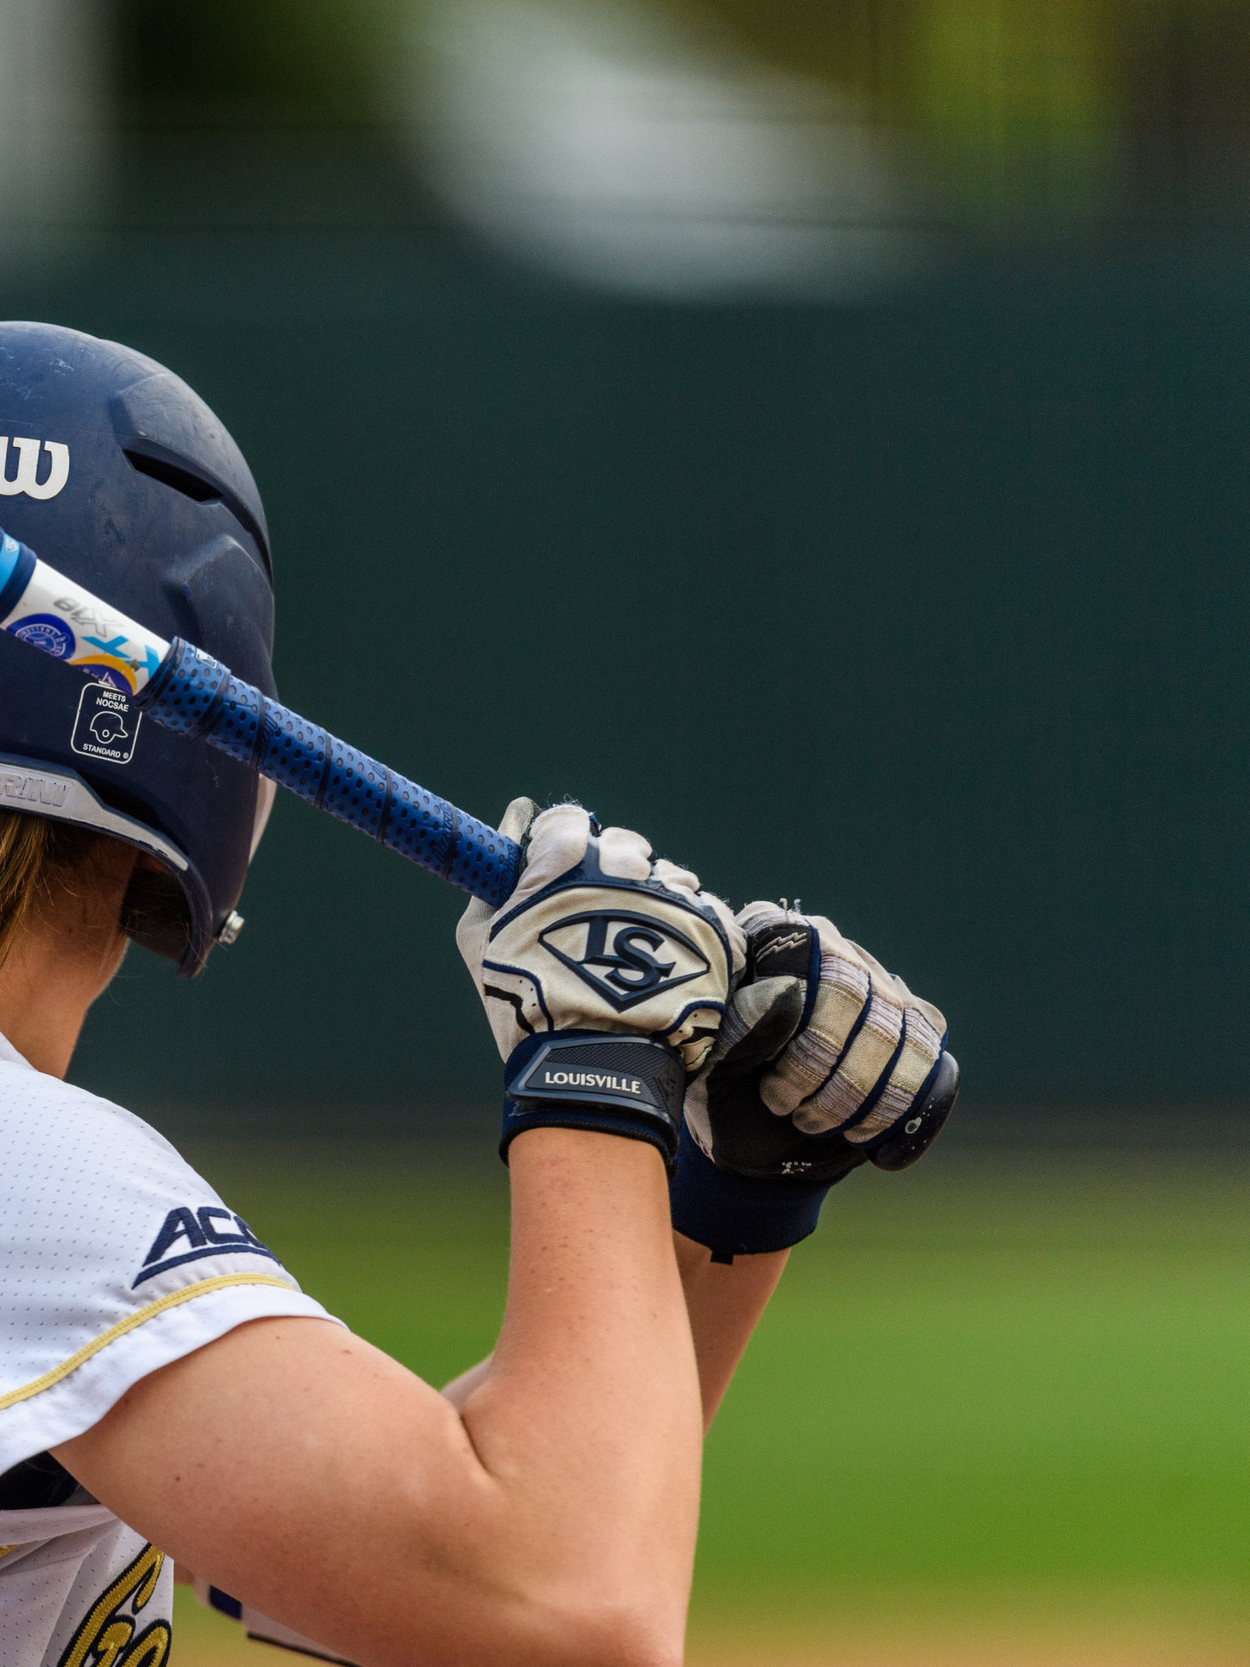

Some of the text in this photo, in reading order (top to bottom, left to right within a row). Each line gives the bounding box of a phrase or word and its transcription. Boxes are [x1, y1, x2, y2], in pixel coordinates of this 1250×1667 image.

[102, 690, 127, 703] MEETS
[95, 697, 129, 712] NOCSAE
[83, 743, 121, 758] STANDARD
[545, 1071, 642, 1094] LOUISVILLE
